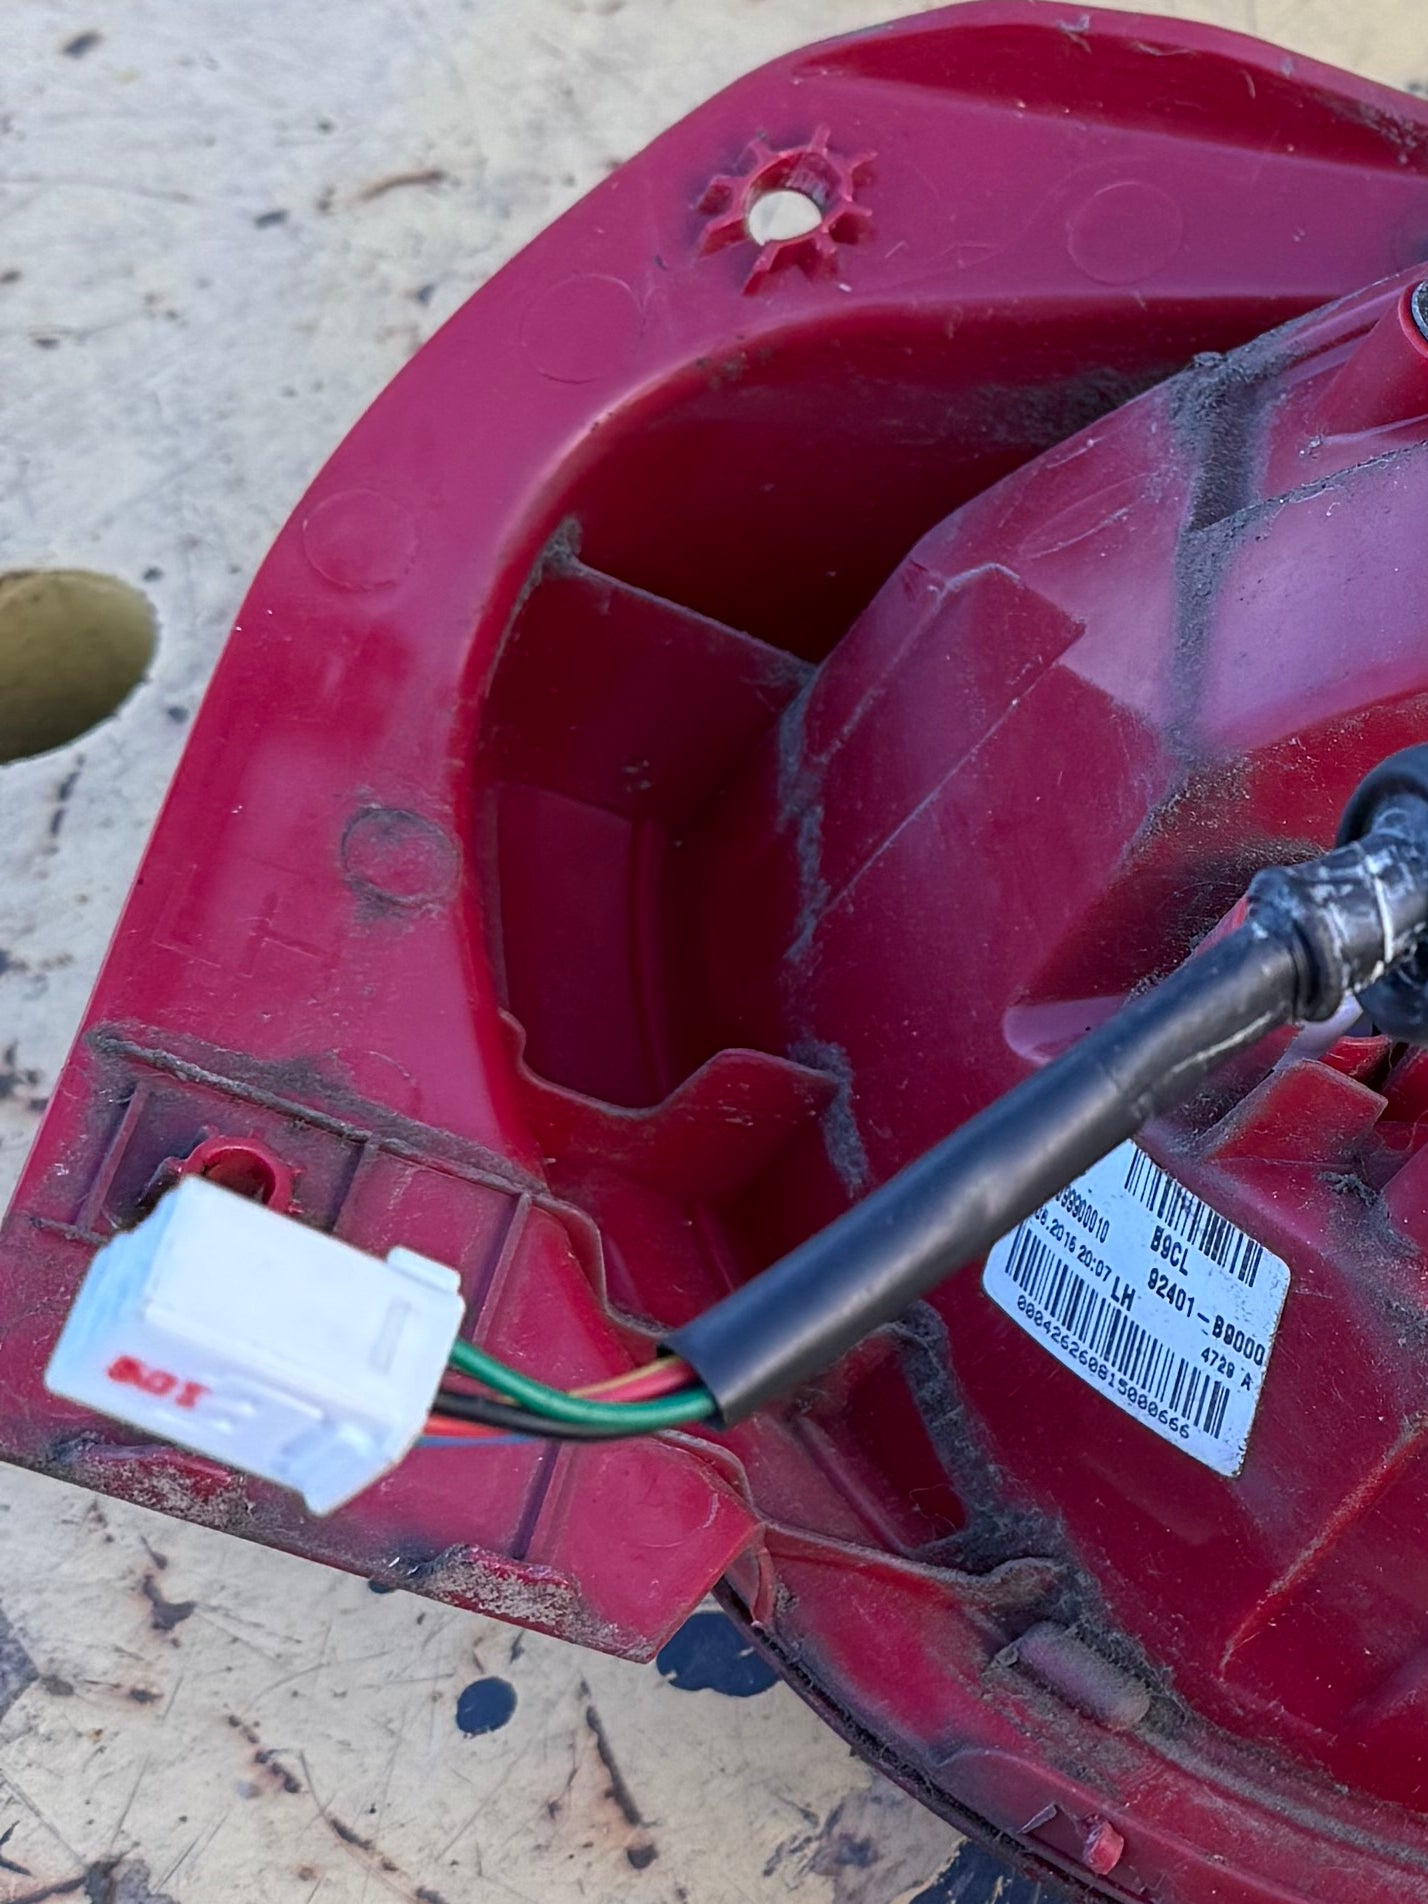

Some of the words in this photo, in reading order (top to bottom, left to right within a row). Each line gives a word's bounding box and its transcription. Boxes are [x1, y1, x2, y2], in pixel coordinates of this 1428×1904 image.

[1077, 1244, 1112, 1282] 20:07
[1111, 1275, 1136, 1311] LH
[1150, 1225, 1188, 1276] B9CL
